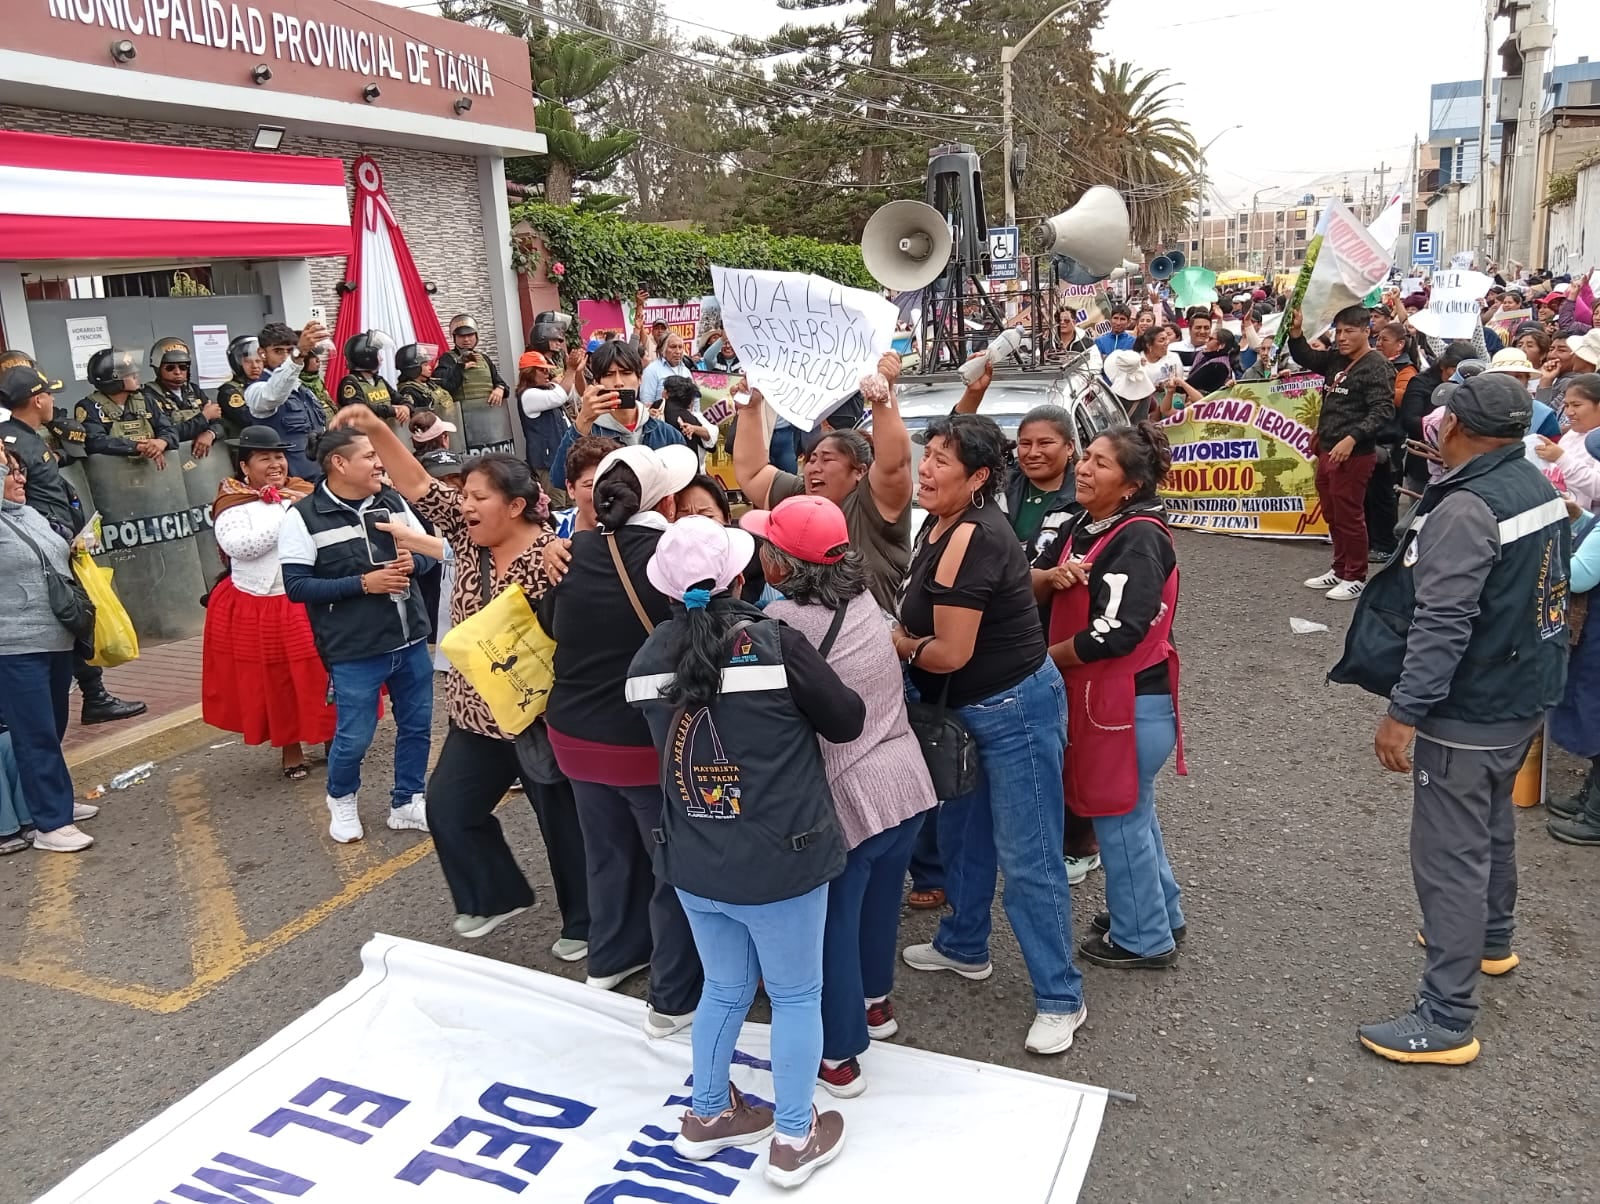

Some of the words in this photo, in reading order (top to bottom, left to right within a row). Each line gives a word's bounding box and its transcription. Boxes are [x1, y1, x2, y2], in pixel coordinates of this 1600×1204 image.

[272, 12, 402, 80] PROVINCIAL
[406, 41, 432, 86] DE
[434, 49, 494, 96] TACNA
[1418, 238, 1430, 252] E
[722, 272, 758, 312] NO
[770, 280, 791, 312] A
[806, 280, 852, 322] LA
[747, 315, 875, 363] REVERSIÓN
[740, 343, 769, 368] DEL
[773, 346, 858, 391] MERCADO
[703, 400, 732, 424] ELIZ
[1193, 401, 1252, 423] TACNA
[1255, 406, 1313, 459] HEROICA
[1171, 440, 1258, 461] MAYORISTA
[1162, 467, 1254, 492] HOLOLO
[1166, 499, 1188, 511] SAN
[1193, 499, 1237, 511] ISIDRO
[1241, 498, 1304, 512] MAYORISTA
[1190, 515, 1208, 526] DE
[1212, 516, 1249, 529] TACNA
[103, 512, 193, 549] POLICIA
[674, 712, 693, 765] MERCADO
[675, 770, 691, 801] GRAN
[693, 765, 740, 773] MAYORISTA
[248, 1077, 412, 1145] EL
[393, 1081, 597, 1194] DEL
